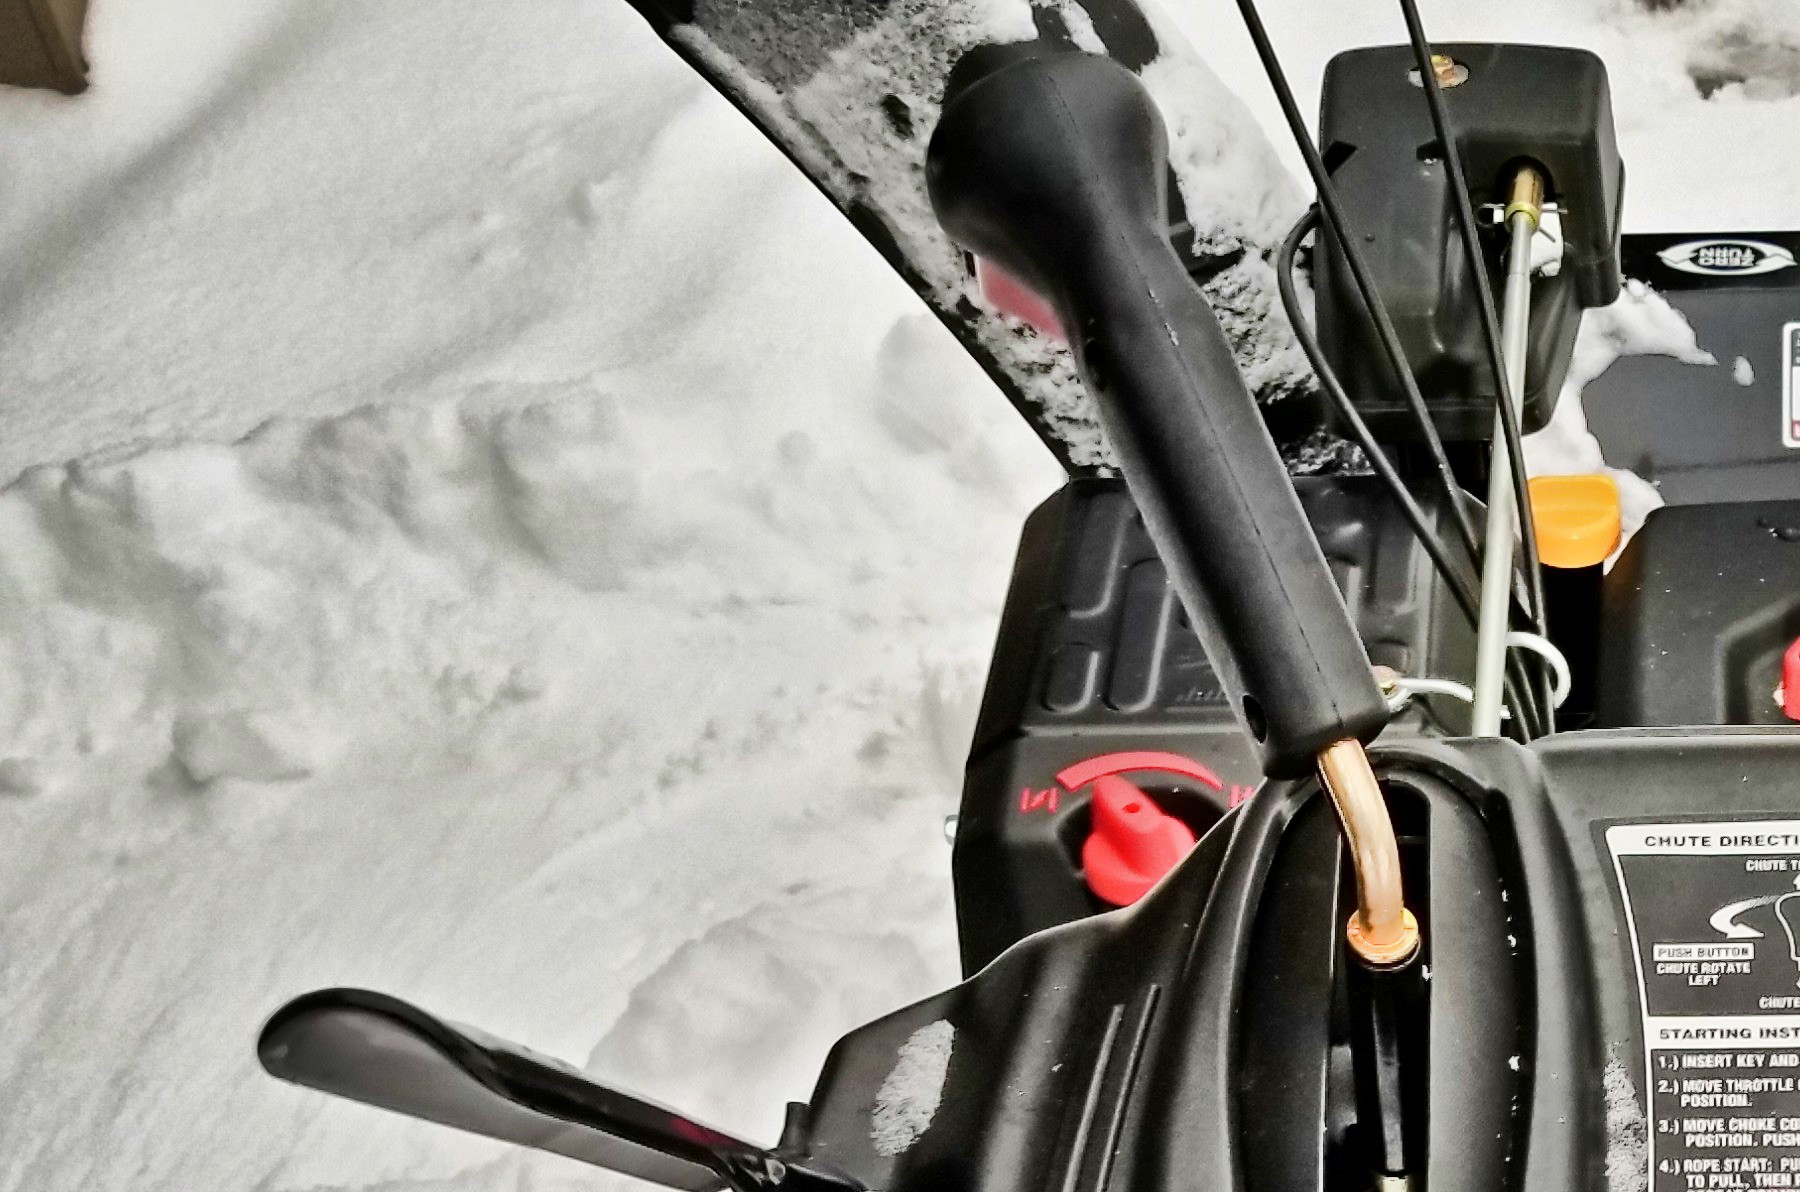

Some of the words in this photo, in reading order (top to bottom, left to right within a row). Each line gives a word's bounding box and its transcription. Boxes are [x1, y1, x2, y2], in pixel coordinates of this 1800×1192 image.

[1645, 835, 1712, 847] CHUTE
[1746, 859, 1787, 871] CHUTE
[1658, 948, 1692, 958] PUSH
[1698, 947, 1749, 958] BUTTON
[1656, 963, 1699, 975] CHUTE
[1701, 962, 1750, 974] ROTATE
[1688, 974, 1720, 986] LEFT
[1759, 996, 1800, 1009] CHUTE
[1660, 1027, 1752, 1041] STARTING
[1658, 1055, 1679, 1070] 1.)
[1682, 1053, 1732, 1069] INSERT
[1736, 1053, 1765, 1068] KEY
[1769, 1053, 1799, 1067] AND
[1657, 1079, 1679, 1095] 2.)
[1682, 1079, 1722, 1093] MOVE
[1726, 1077, 1794, 1092] THROTTLE
[1680, 1093, 1752, 1108] POSITION.
[1658, 1119, 1679, 1135] 3.)
[1682, 1118, 1725, 1133] MOVE
[1728, 1117, 1776, 1132] CHOKE
[1685, 1133, 1758, 1148] POSITION.
[1762, 1133, 1800, 1147] PUSH
[1659, 1159, 1681, 1175] 4.)
[1683, 1159, 1721, 1173] ROPE
[1724, 1157, 1772, 1173] START:
[1686, 1174, 1705, 1189] TO
[1709, 1174, 1750, 1190] PULL,
[1754, 1173, 1791, 1188] THEN
